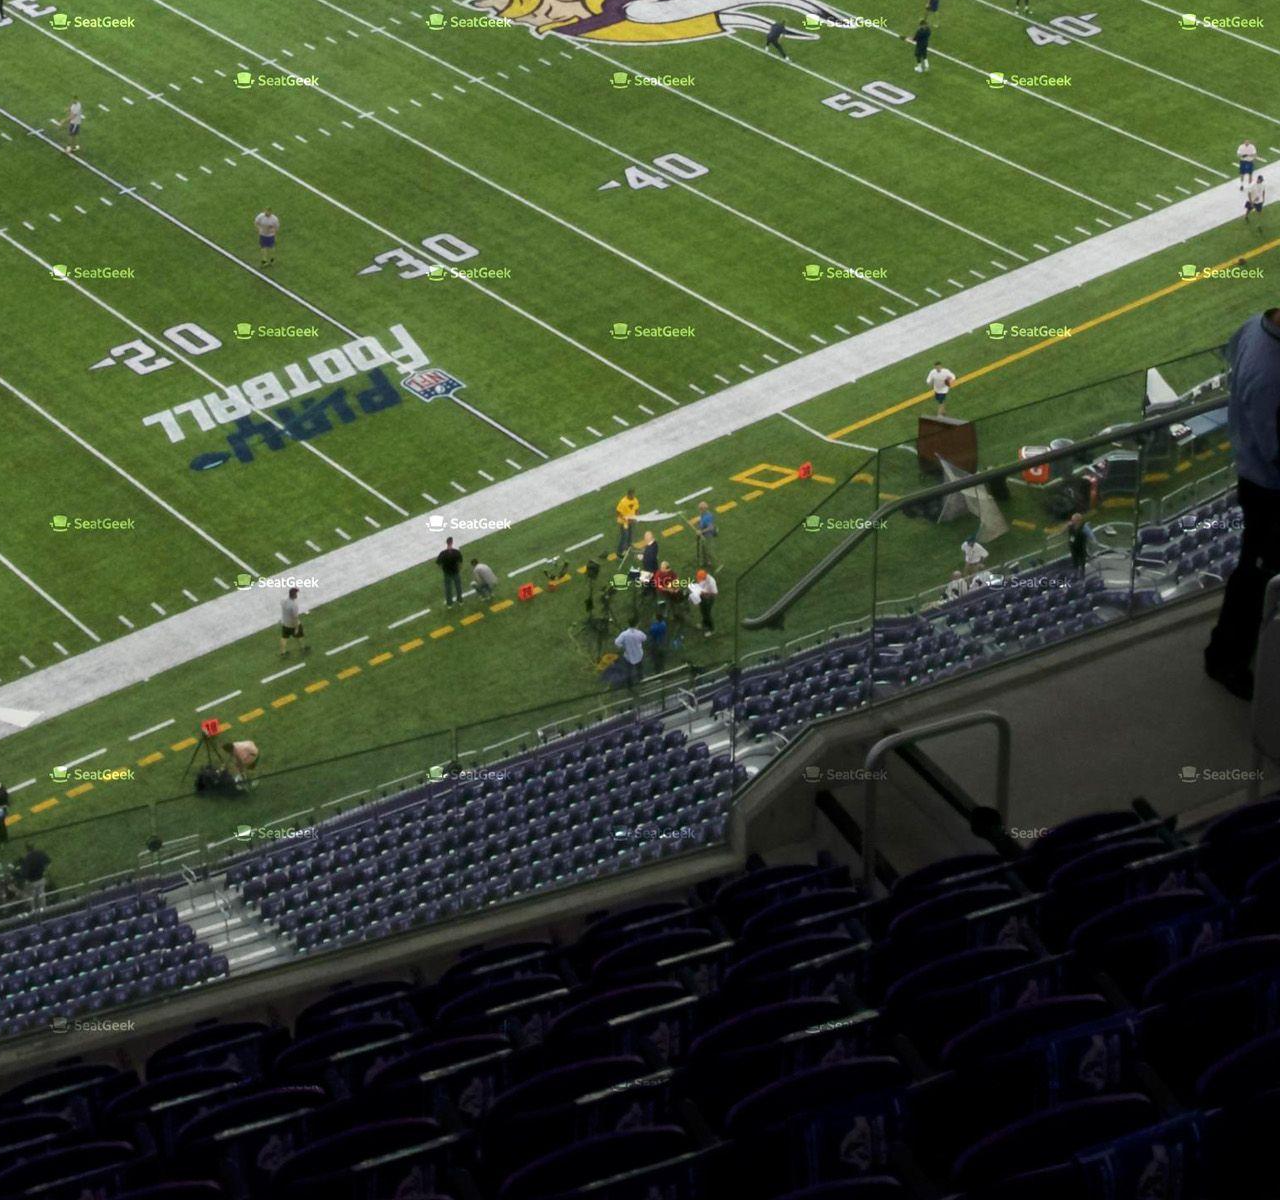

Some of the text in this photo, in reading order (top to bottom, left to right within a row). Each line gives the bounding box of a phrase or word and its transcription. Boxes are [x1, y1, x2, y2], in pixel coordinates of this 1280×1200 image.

[1025, 16, 1103, 46] 40
[822, 80, 917, 119] 50
[622, 152, 710, 191] 40
[375, 233, 481, 280] 30
[109, 322, 223, 375] 20
[143, 324, 431, 444] FOOTBALL
[409, 371, 444, 389] NFL
